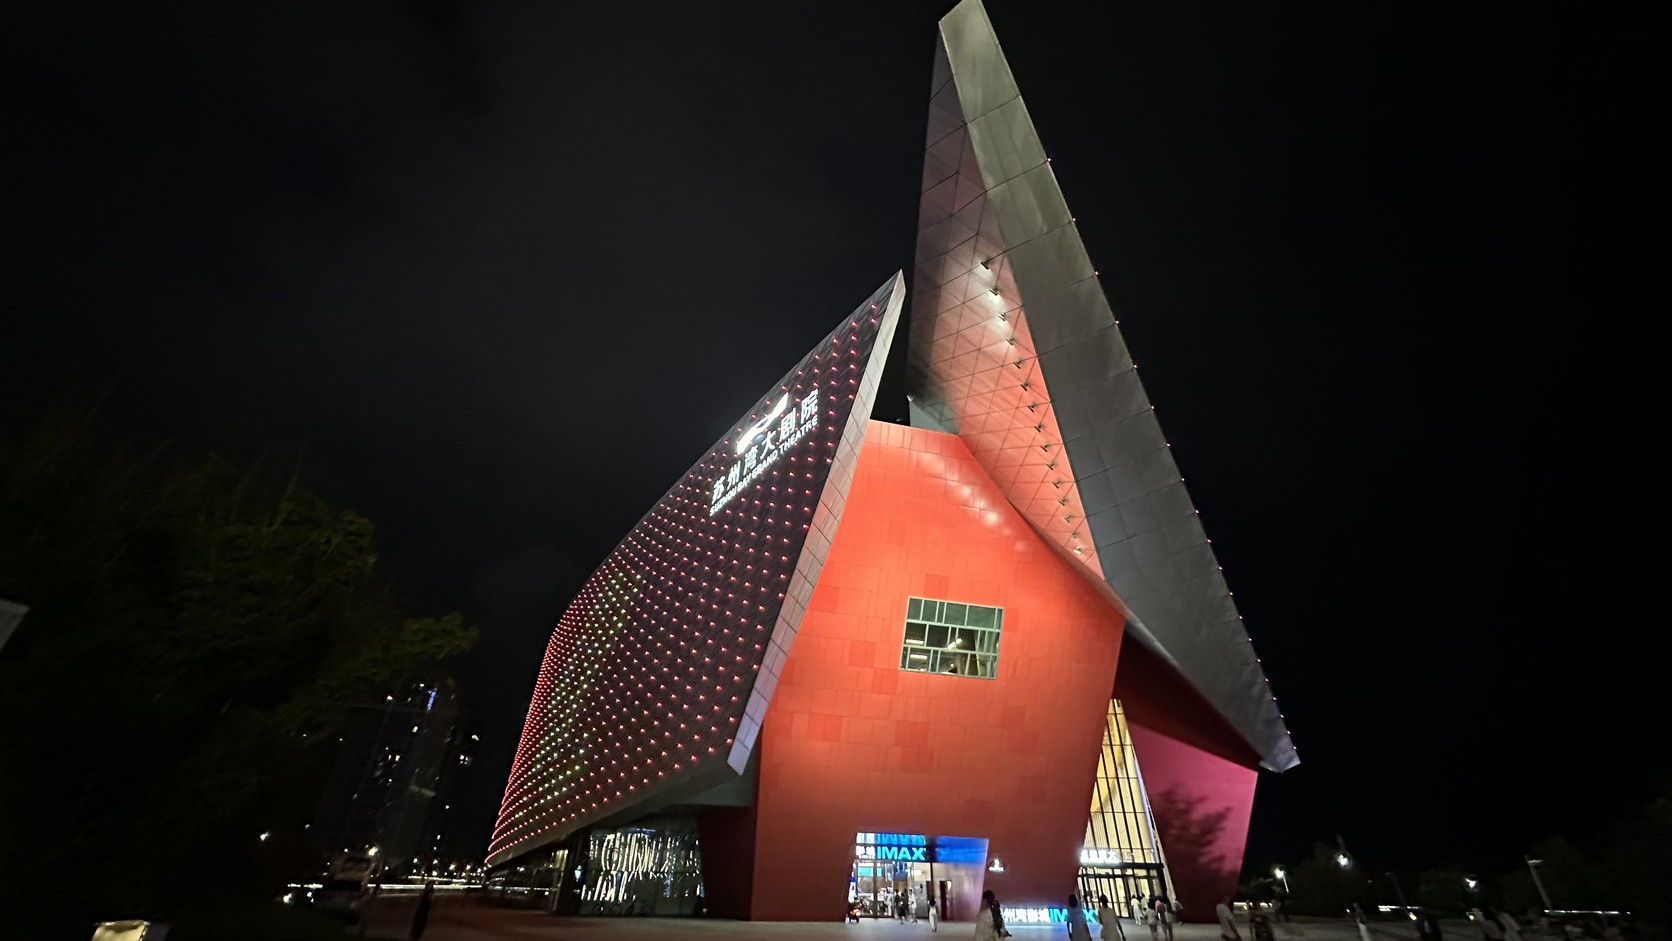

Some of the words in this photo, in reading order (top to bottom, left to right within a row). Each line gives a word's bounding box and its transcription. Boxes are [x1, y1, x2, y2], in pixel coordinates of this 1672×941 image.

[709, 486, 738, 517] SUZHOU
[737, 472, 752, 492] BAY
[751, 449, 779, 479] GRAND
[779, 414, 819, 455] THEATRE
[711, 388, 819, 505] 苏州湾大剧院
[877, 846, 926, 861] IMAX
[1049, 908, 1098, 923] IMX
